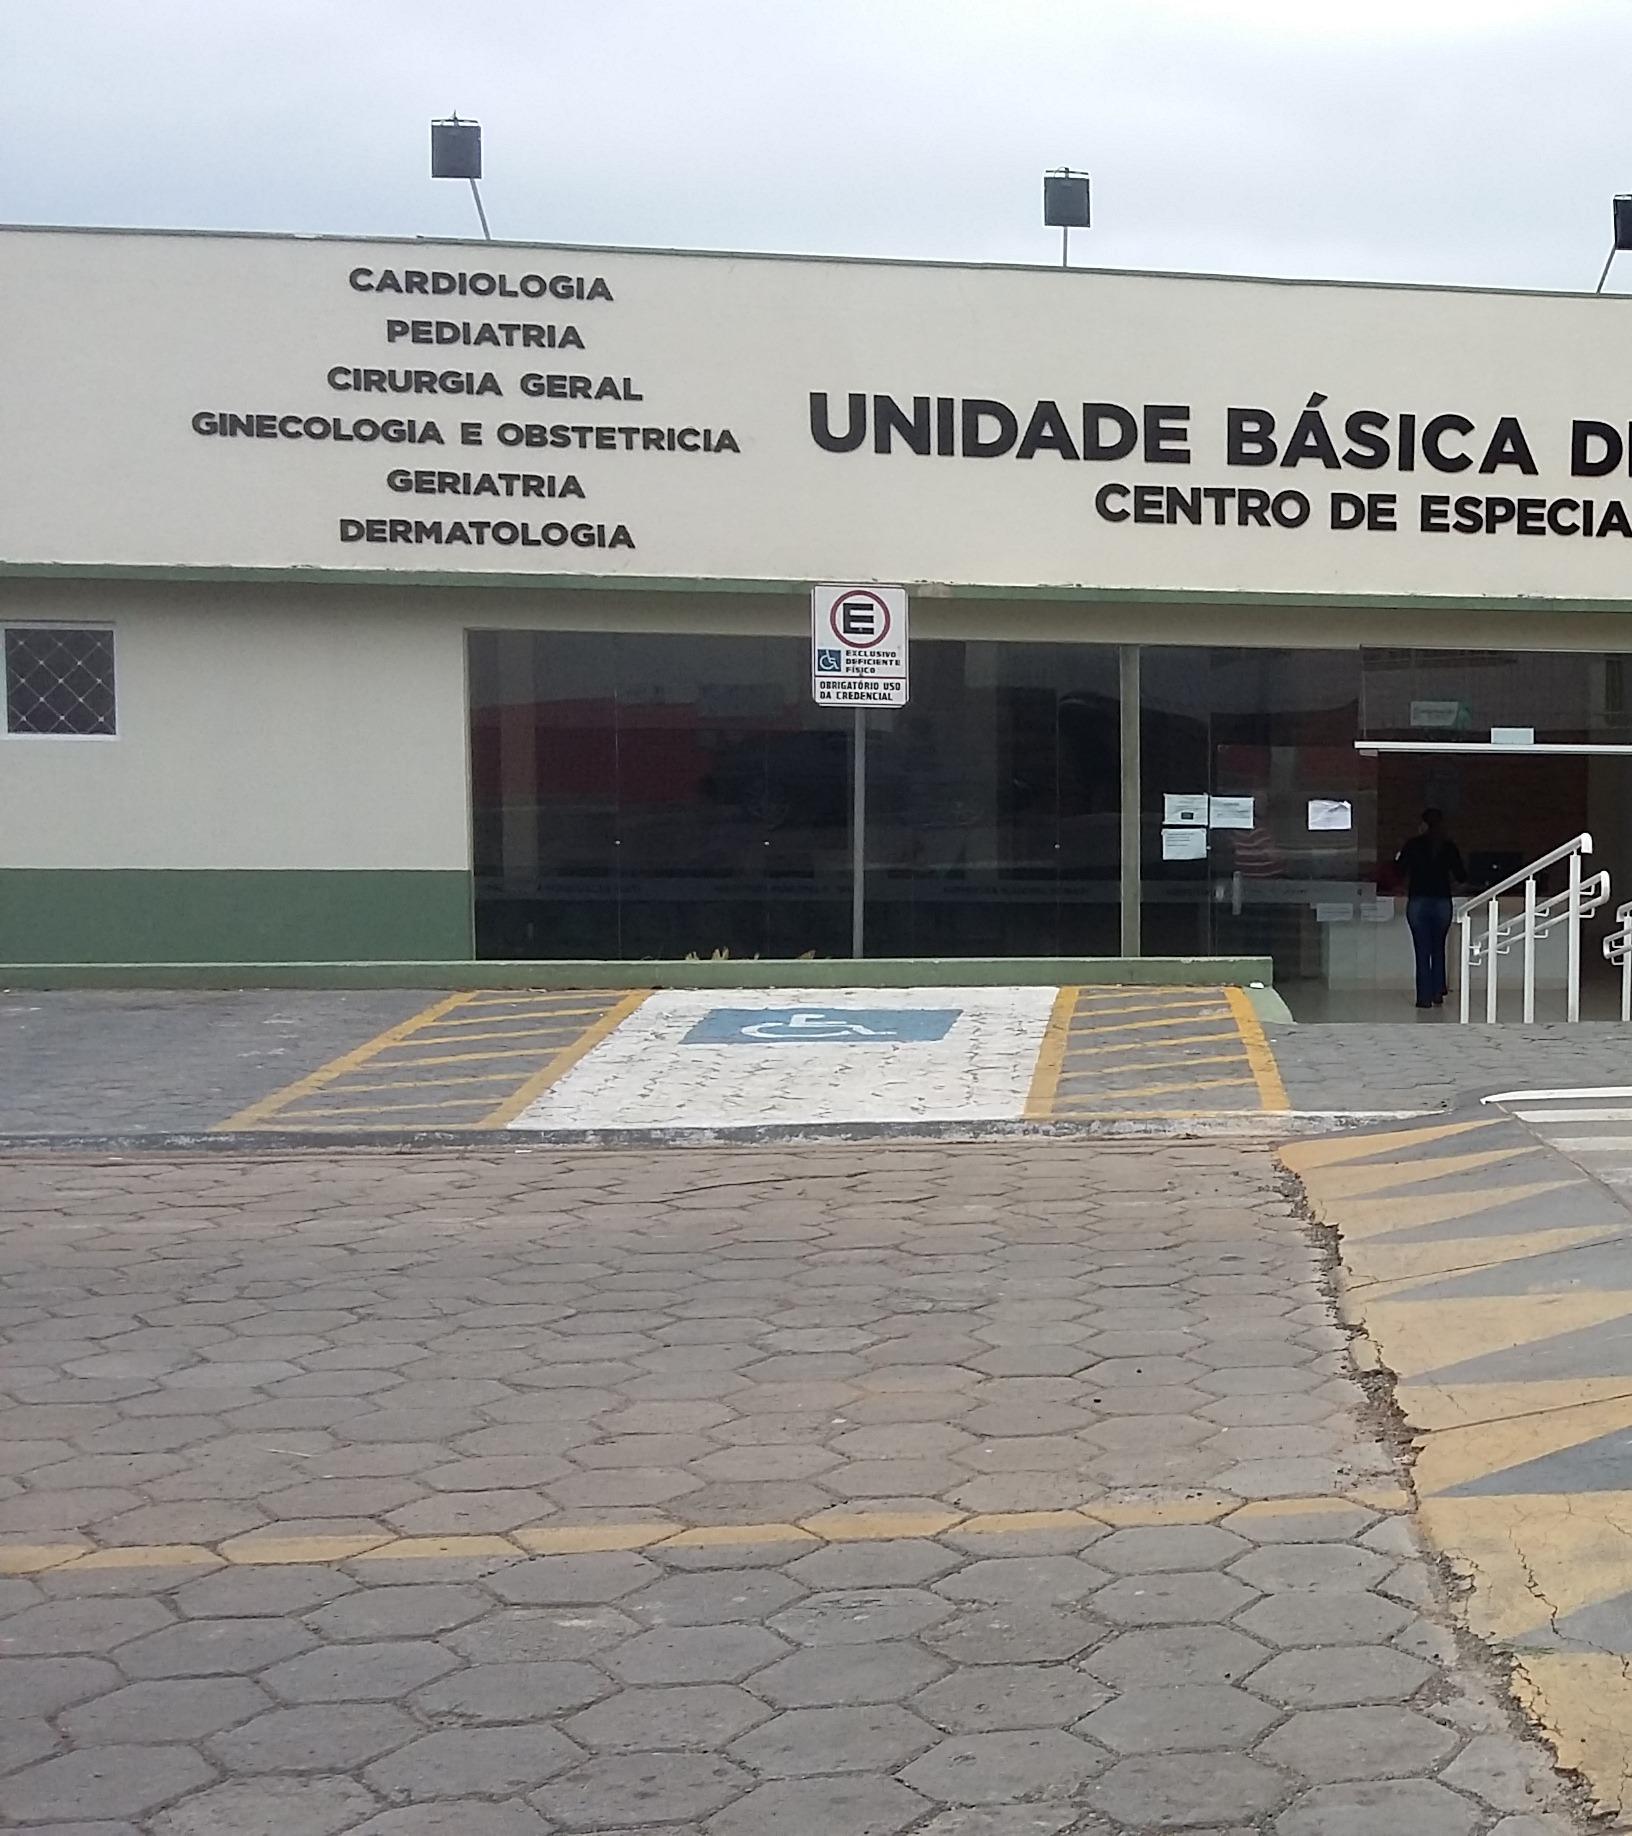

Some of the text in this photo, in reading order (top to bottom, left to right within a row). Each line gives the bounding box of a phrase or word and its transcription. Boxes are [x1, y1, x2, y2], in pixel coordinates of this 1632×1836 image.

[349, 268, 614, 301] CARDIOLOGIA
[387, 320, 585, 349] PEDIATRIA
[327, 367, 643, 402] CIRURGIA GERAL
[192, 412, 740, 453] GINECOLOGIA E OBSTETRICIA
[809, 392, 1191, 465] UNIDADE
[1226, 392, 1540, 477] BÁSICA
[387, 469, 585, 499] GERIATRIA
[1095, 483, 1310, 529] CENTRO
[1331, 493, 1398, 532] DE
[340, 519, 635, 549] DERMATOLOGIA
[842, 602, 874, 635] E
[845, 650, 897, 658] EXCLUSIVO
[845, 658, 901, 666] DEFICIENTE
[845, 666, 876, 674] FÍSICO
[819, 680, 901, 691] OBRIGATÓRIO USO
[819, 691, 893, 701] DA CREDENCIAL
